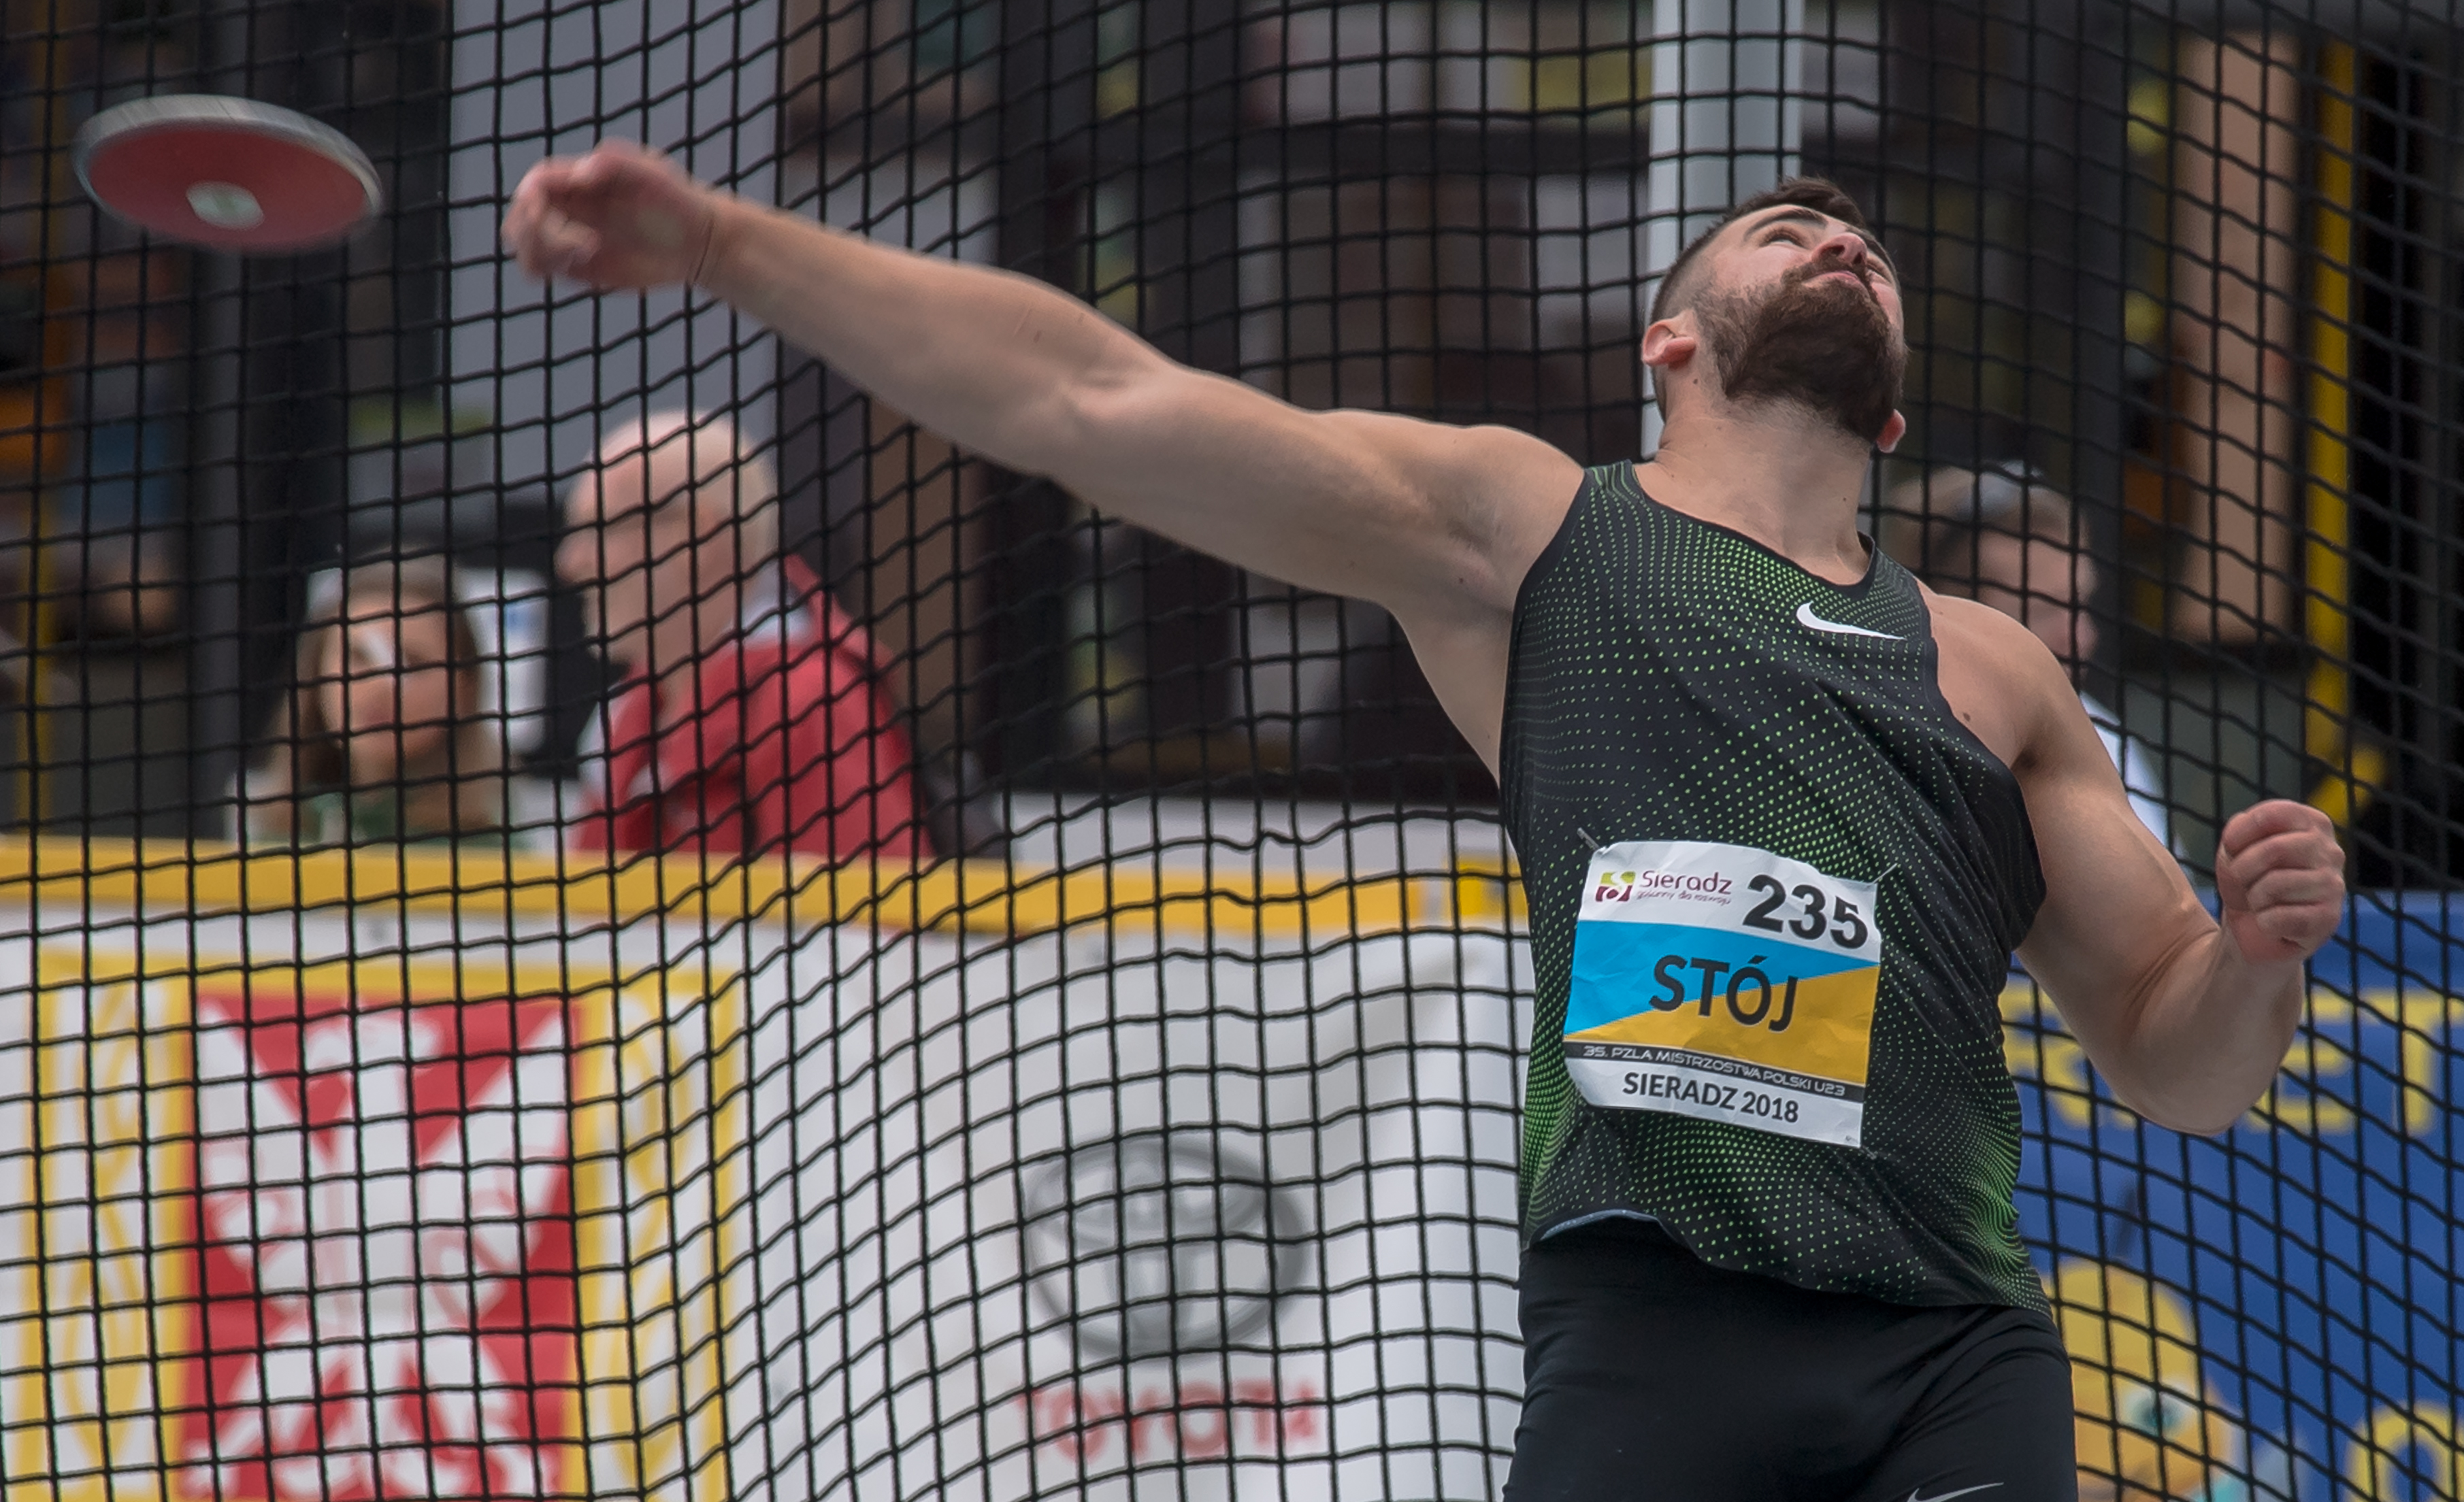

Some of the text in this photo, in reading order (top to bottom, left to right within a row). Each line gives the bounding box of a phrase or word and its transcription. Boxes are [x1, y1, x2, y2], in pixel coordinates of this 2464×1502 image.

[1639, 870, 1733, 895] Sieradz
[1743, 874, 1869, 949] 235
[1648, 954, 1799, 1033] STÓJ
[1583, 1045, 1846, 1096] 35. PZLA MISTRZOSTWA POLSKI U23
[1622, 1071, 1799, 1124] SIERADZ 2018
